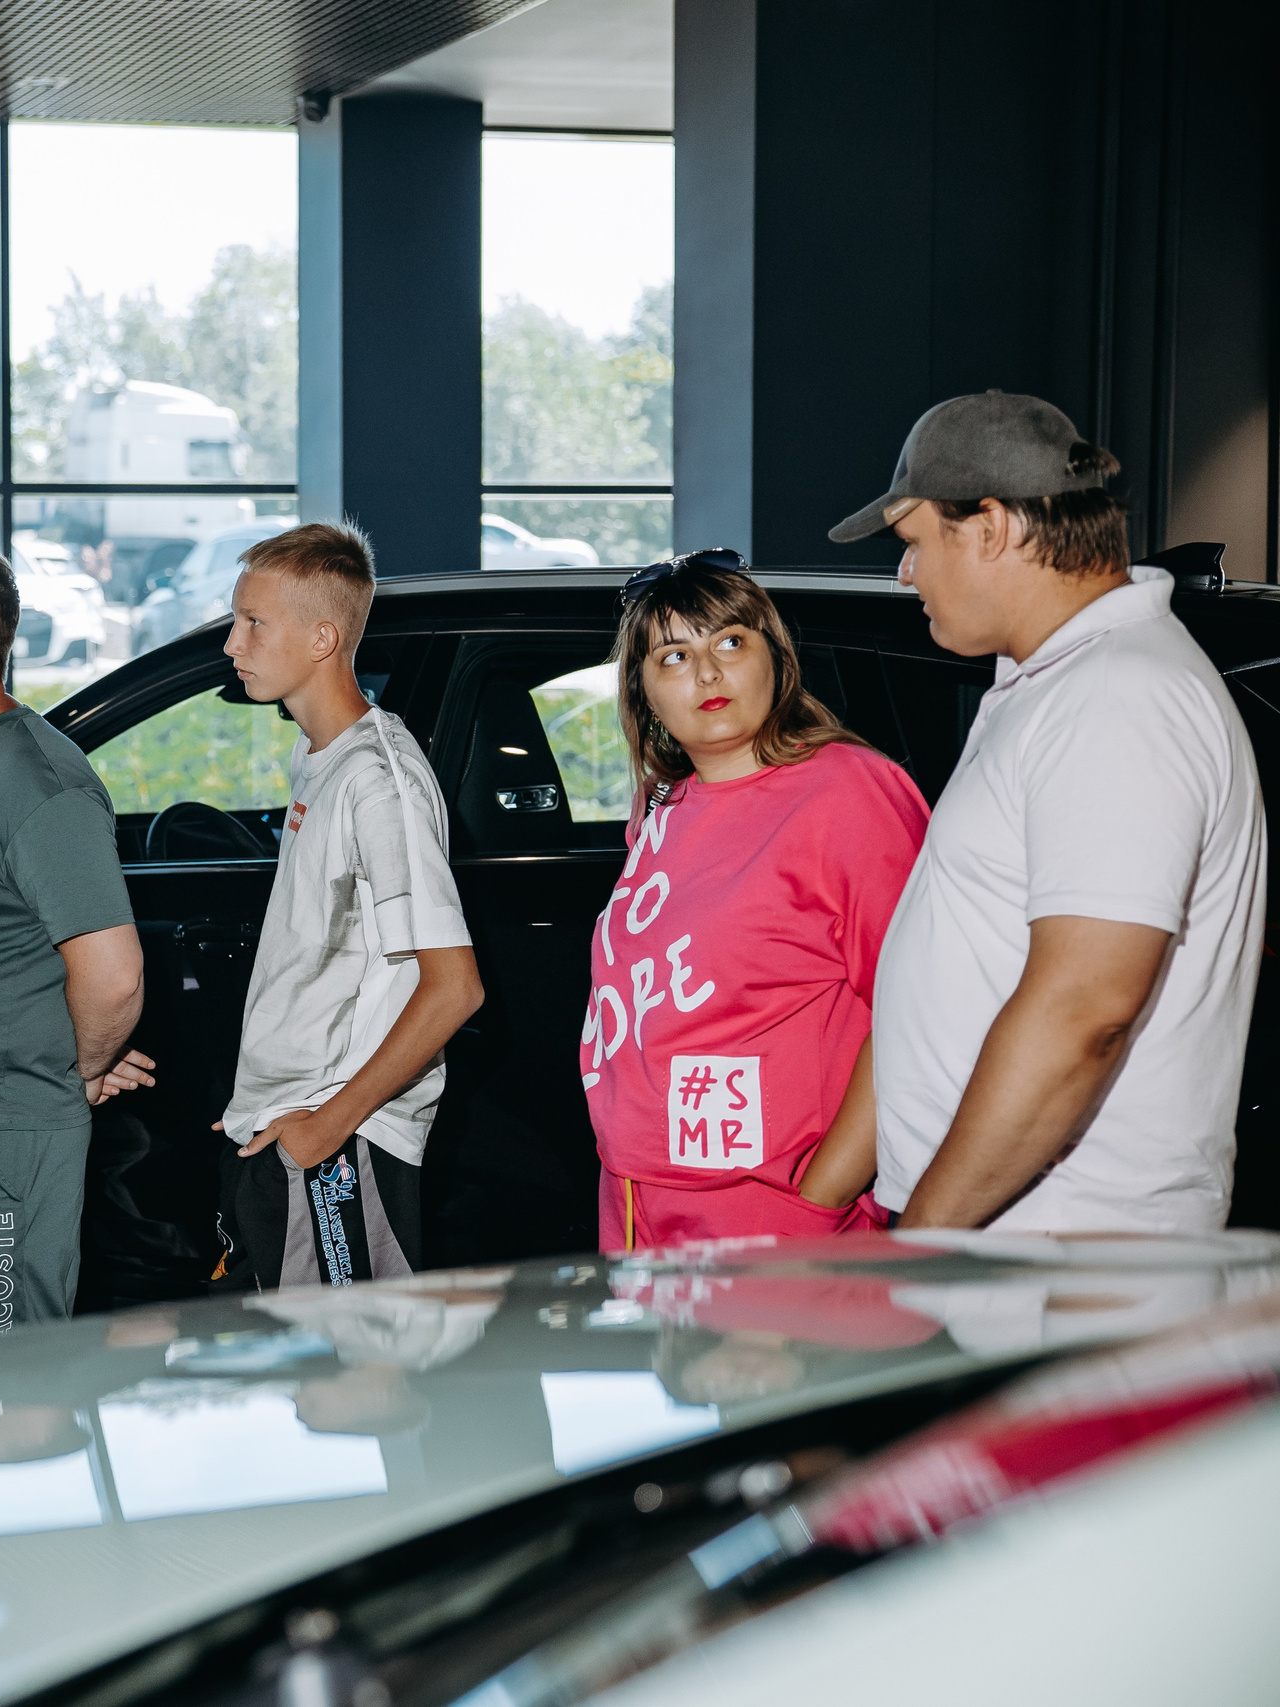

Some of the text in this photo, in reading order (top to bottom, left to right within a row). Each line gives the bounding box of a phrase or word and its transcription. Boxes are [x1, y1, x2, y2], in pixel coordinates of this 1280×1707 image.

[597, 871, 670, 965] TO
[310, 1179, 341, 1287] WORLDWIDE EXPRESS
